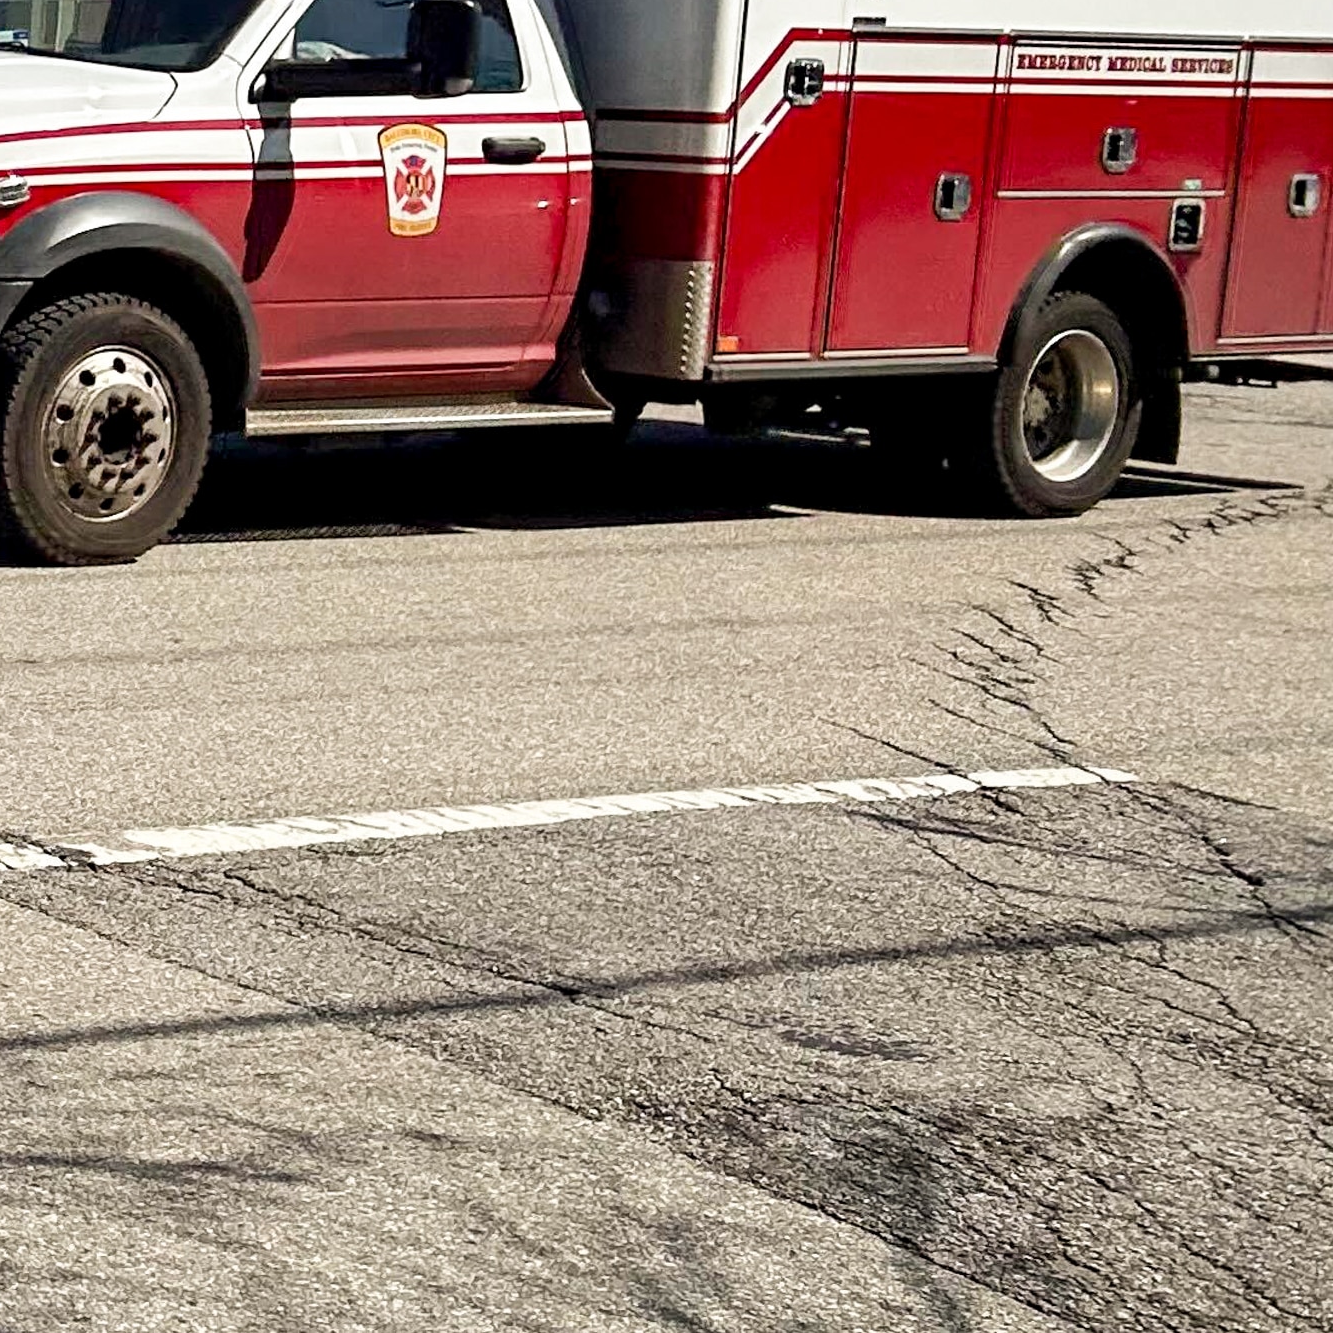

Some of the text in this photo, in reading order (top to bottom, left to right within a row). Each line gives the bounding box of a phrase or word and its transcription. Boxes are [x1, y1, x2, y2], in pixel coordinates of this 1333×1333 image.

[1017, 54, 1233, 74] EMERGENCY MEDICAL SERVICES
